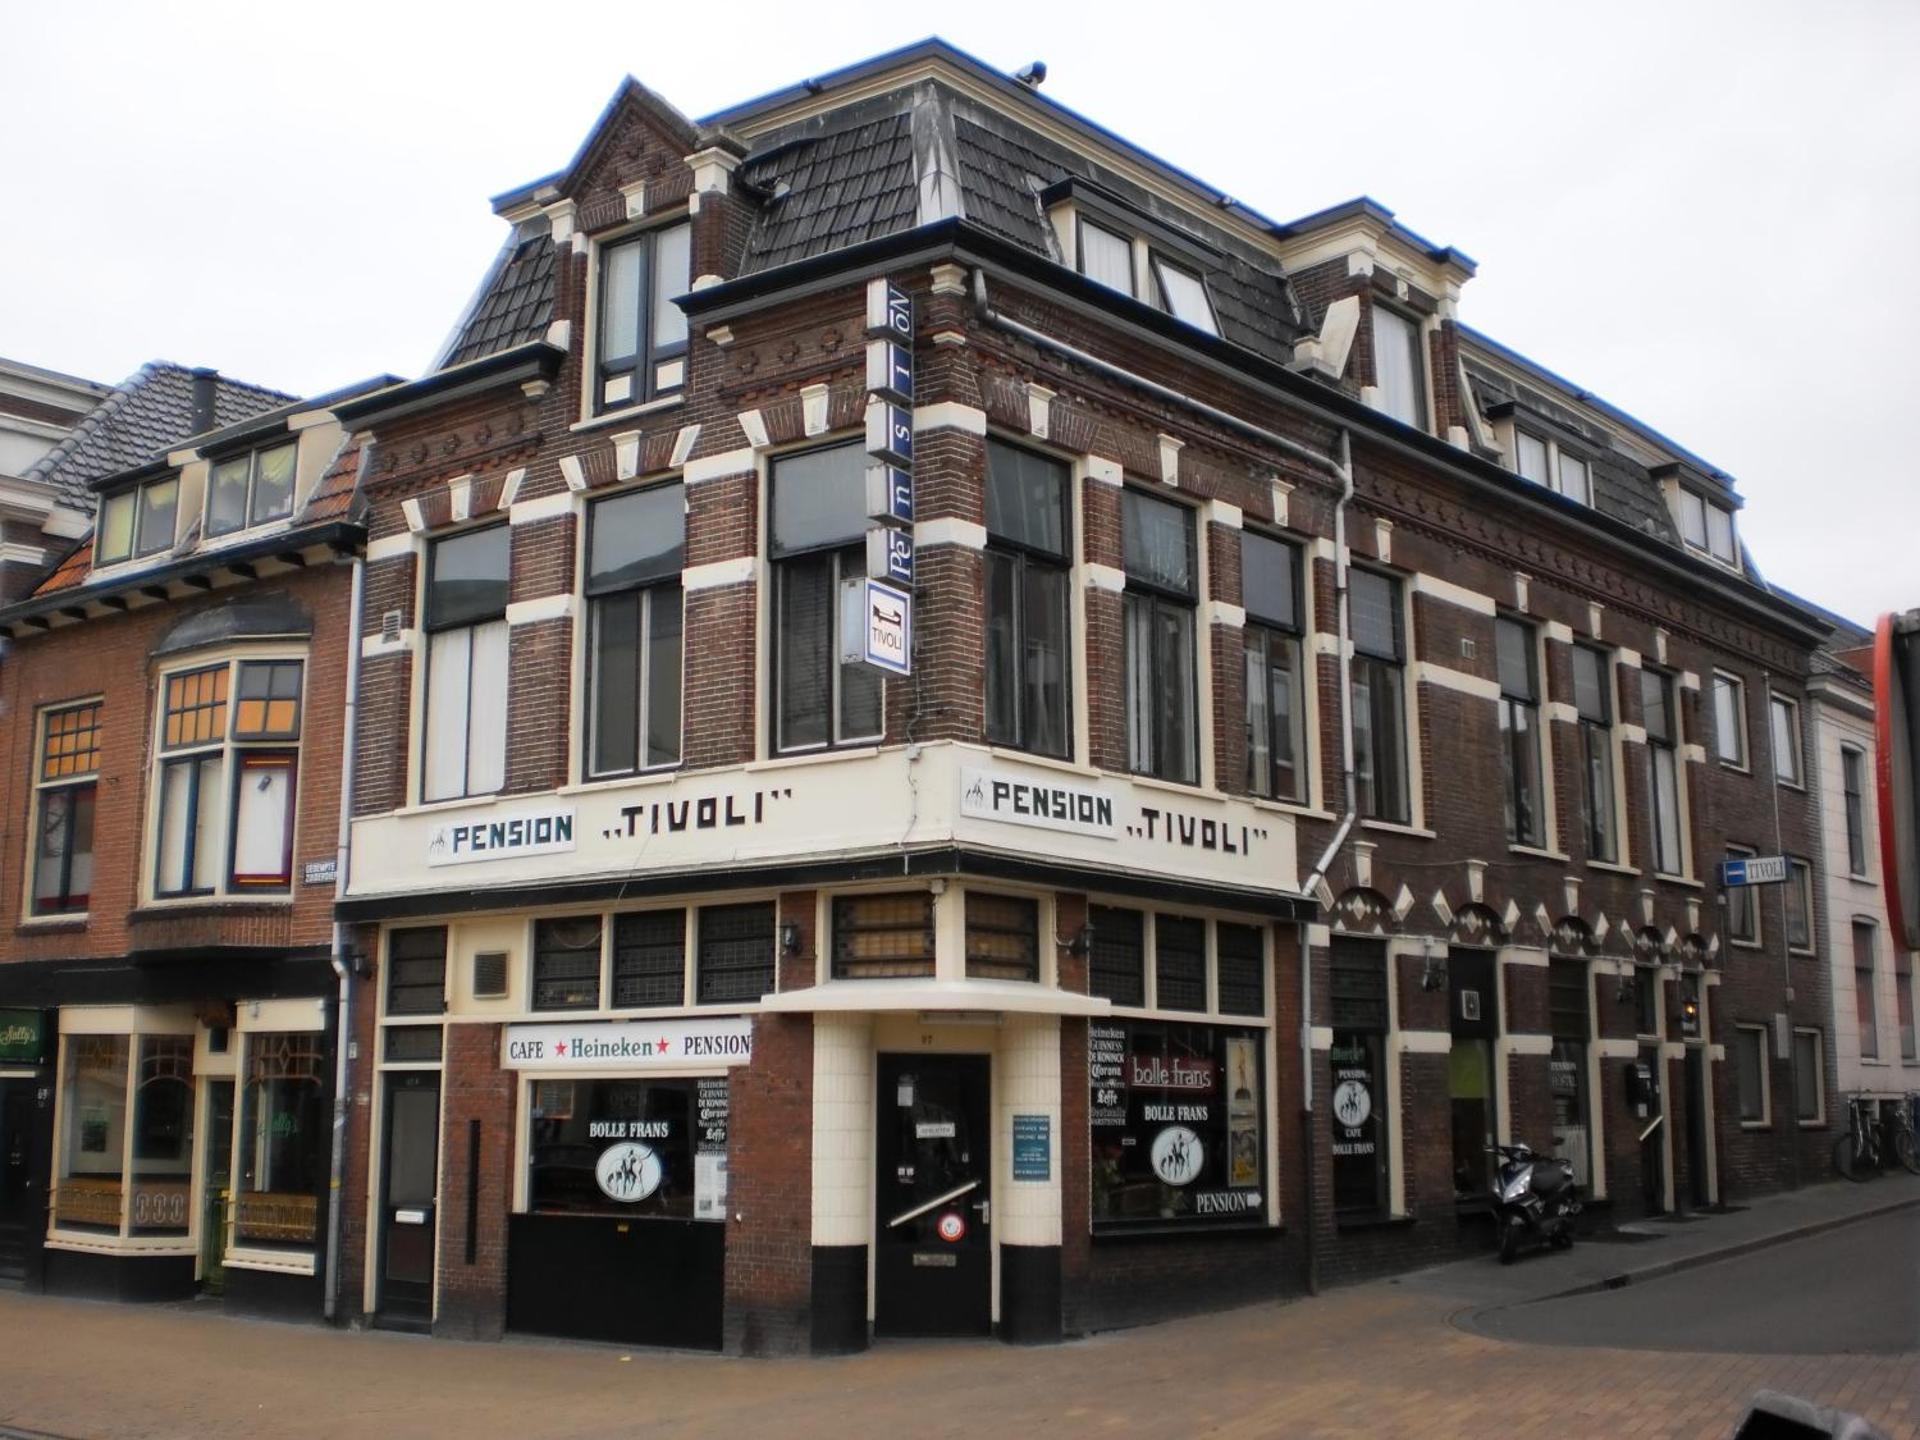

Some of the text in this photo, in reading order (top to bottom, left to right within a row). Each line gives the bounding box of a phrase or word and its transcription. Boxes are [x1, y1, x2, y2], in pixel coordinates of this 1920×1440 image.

[872, 627, 902, 650] TIVOLI
[992, 780, 1113, 826] PENSION
[452, 814, 573, 854] PENSION
[1748, 860, 1784, 880] TIVOLI
[510, 1034, 751, 1059] CAFE Heineken PENSION
[1132, 1056, 1212, 1088] bolle frans
[1144, 1105, 1209, 1121] BOLLE FRANS
[589, 1121, 669, 1138] BOLLE FRANS
[1196, 1191, 1249, 1214] PENSION
